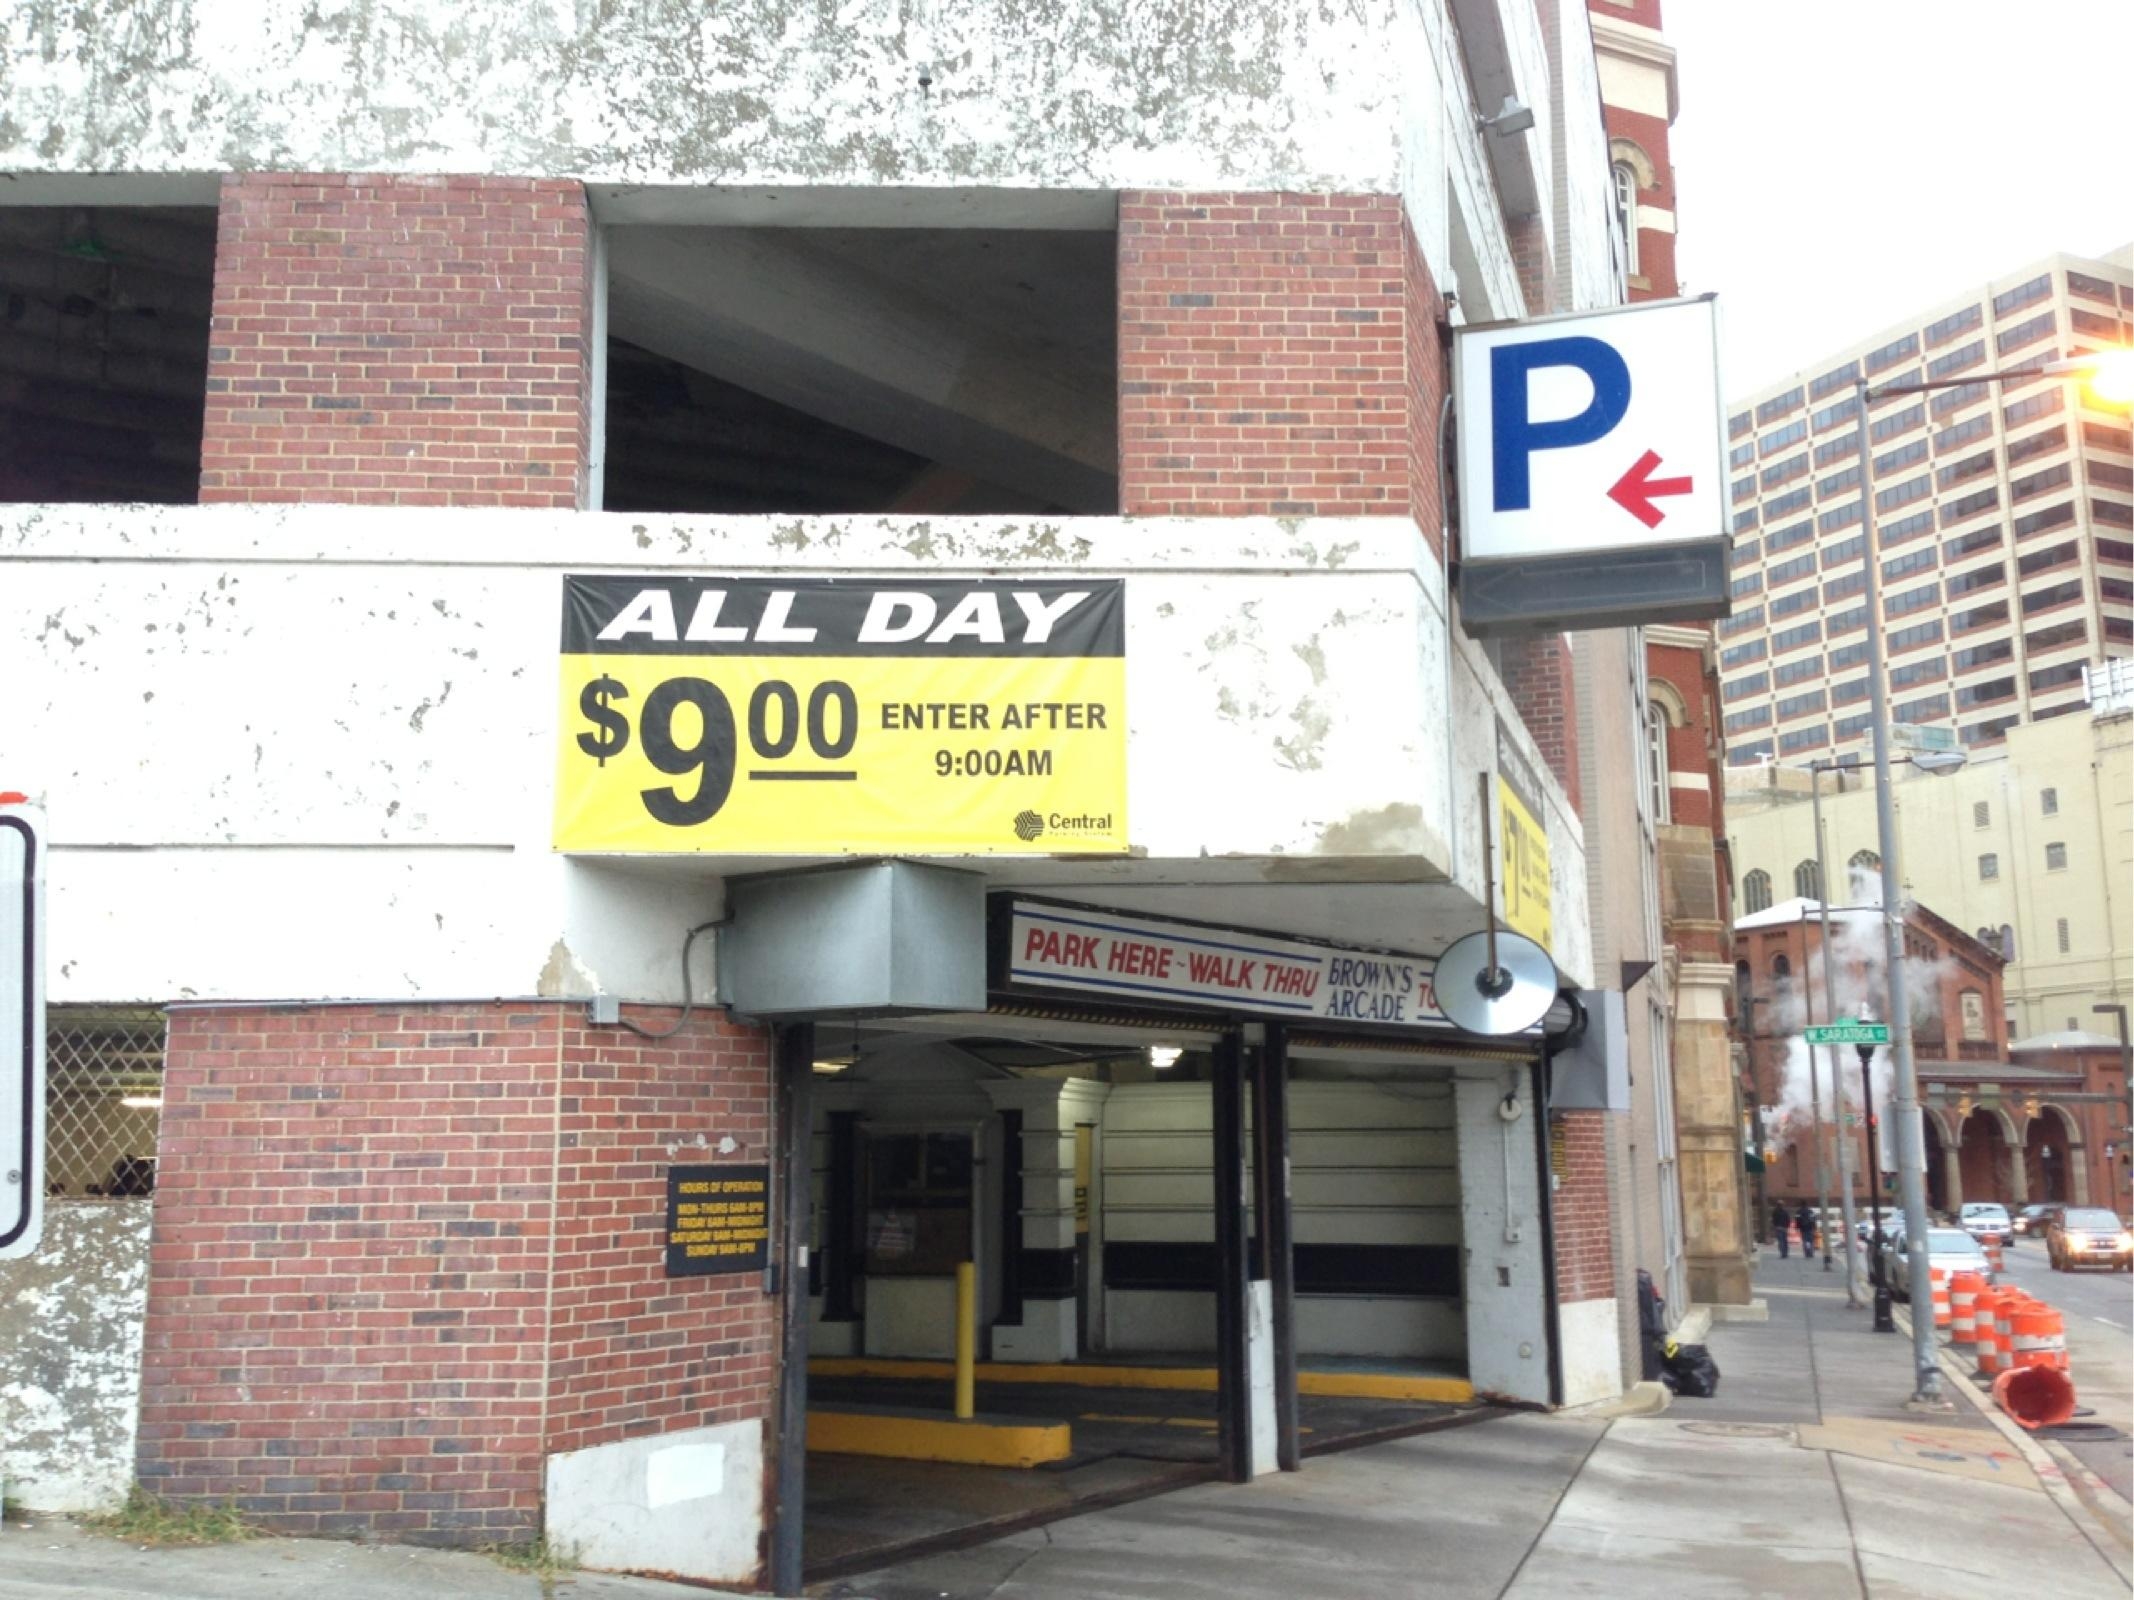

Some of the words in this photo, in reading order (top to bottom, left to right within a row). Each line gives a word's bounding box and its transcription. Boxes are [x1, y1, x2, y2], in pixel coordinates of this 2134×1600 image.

[1490, 336, 1632, 512] P
[596, 589, 818, 642] ALL
[857, 591, 1092, 643] DAY
[881, 703, 989, 730] ENTER
[1001, 703, 1107, 730] AFTER
[935, 749, 1053, 776] 9:00AM
[1049, 813, 1112, 829] Central
[1024, 928, 1101, 969] PARK
[1107, 940, 1174, 978] HERE
[1188, 952, 1256, 991] WALK
[1263, 963, 1320, 997] THRU
[1328, 957, 1413, 993] BROWN'S
[1325, 990, 1407, 1021] ARCADE
[678, 1182, 709, 1193] HOURS
